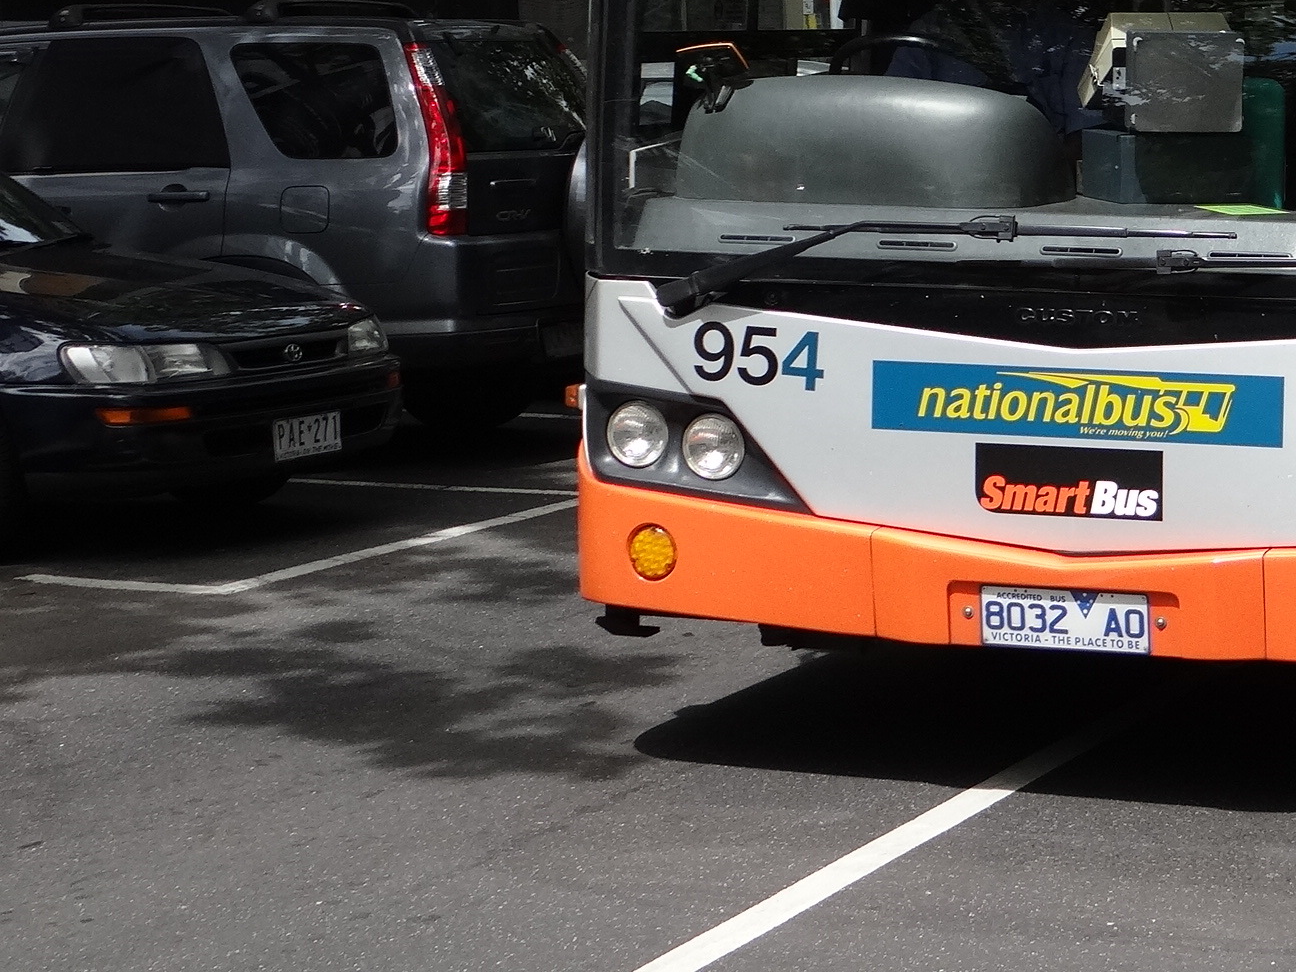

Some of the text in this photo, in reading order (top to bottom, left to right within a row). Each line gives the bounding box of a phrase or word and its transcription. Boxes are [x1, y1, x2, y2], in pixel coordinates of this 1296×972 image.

[693, 321, 825, 392] 954
[917, 383, 1178, 428] nationalbus
[1079, 426, 1168, 439] We're moving you!
[980, 475, 1159, 517] SmartBus
[996, 591, 1067, 603] ACCREDITED BUS
[984, 600, 1069, 635] 8032
[991, 631, 1042, 644] VICTORIA
[1052, 635, 1072, 646] THE
[1074, 637, 1108, 648] PLACE
[1110, 639, 1125, 649] TO
[1127, 640, 1140, 650] BE
